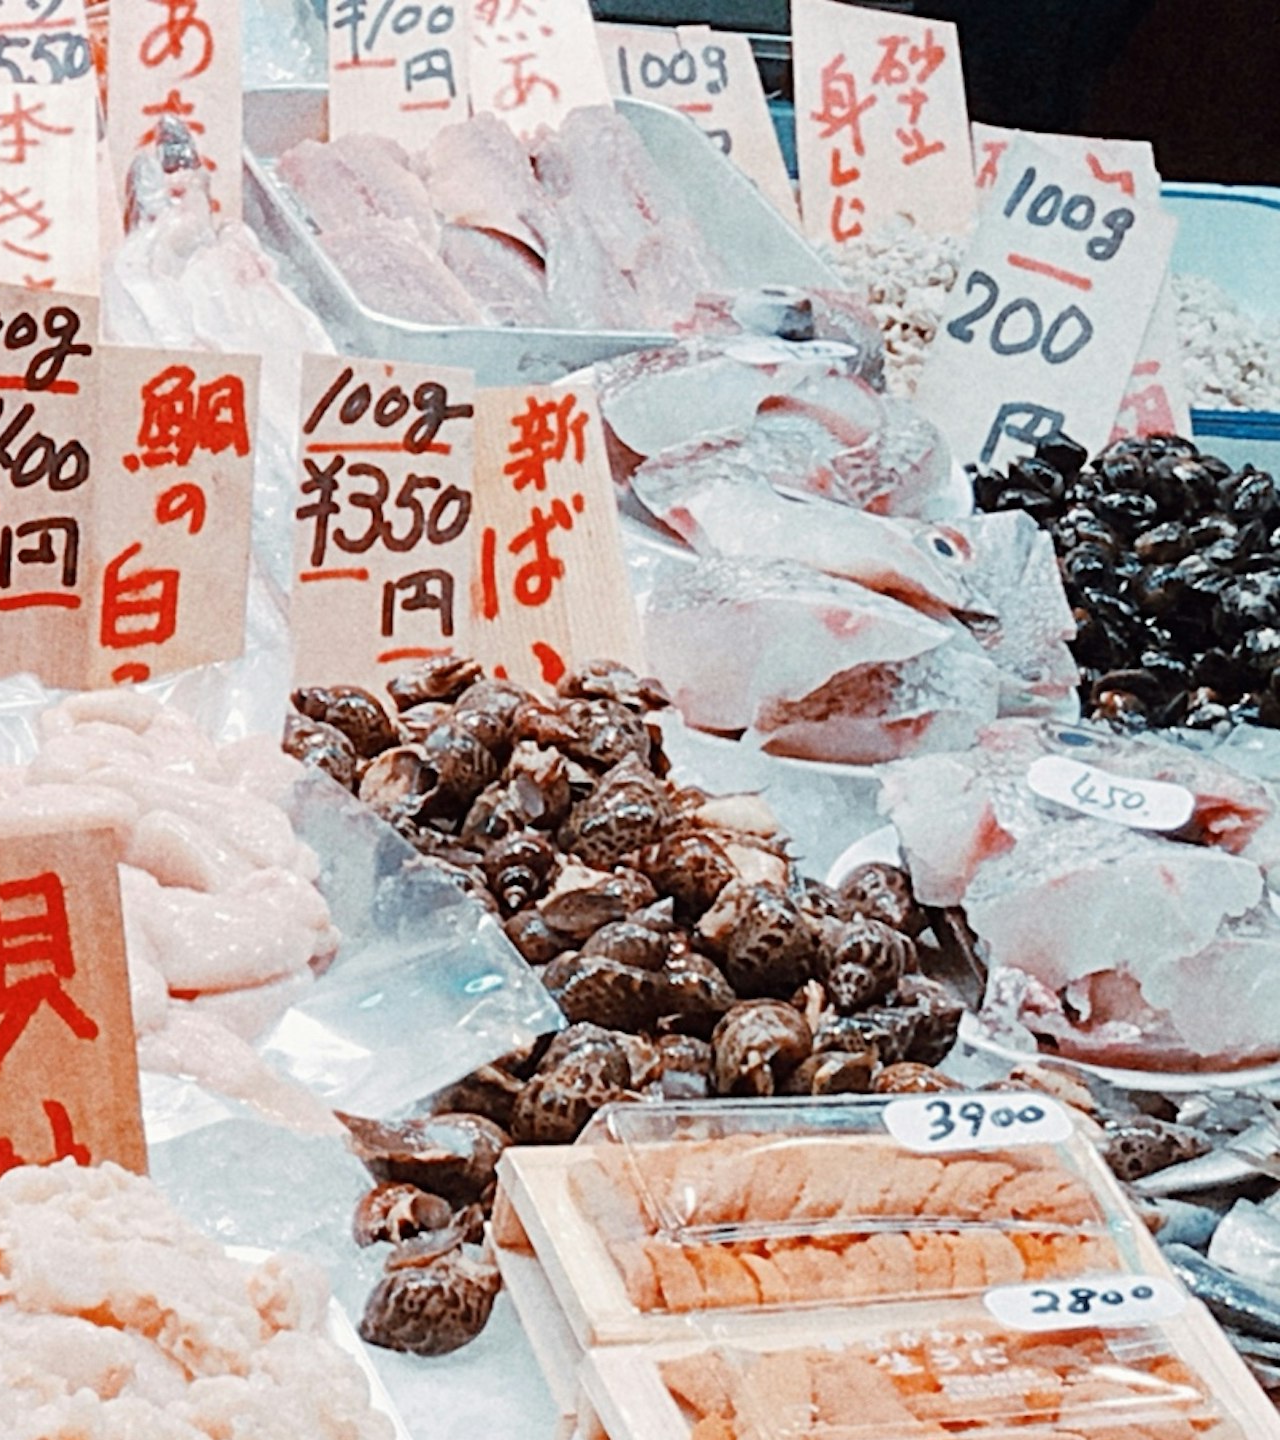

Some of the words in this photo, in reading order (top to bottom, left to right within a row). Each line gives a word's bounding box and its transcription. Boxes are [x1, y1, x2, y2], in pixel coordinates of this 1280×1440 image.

[405, 48, 457, 98] 円
[618, 46, 729, 95] 100g
[1003, 166, 1135, 261] 100g
[946, 270, 1094, 365] 200
[303, 367, 474, 455] 100g
[296, 454, 472, 567] ¥350
[381, 568, 454, 637] 円
[926, 1100, 1046, 1142] 3900
[1030, 1285, 1154, 1316] 2800
